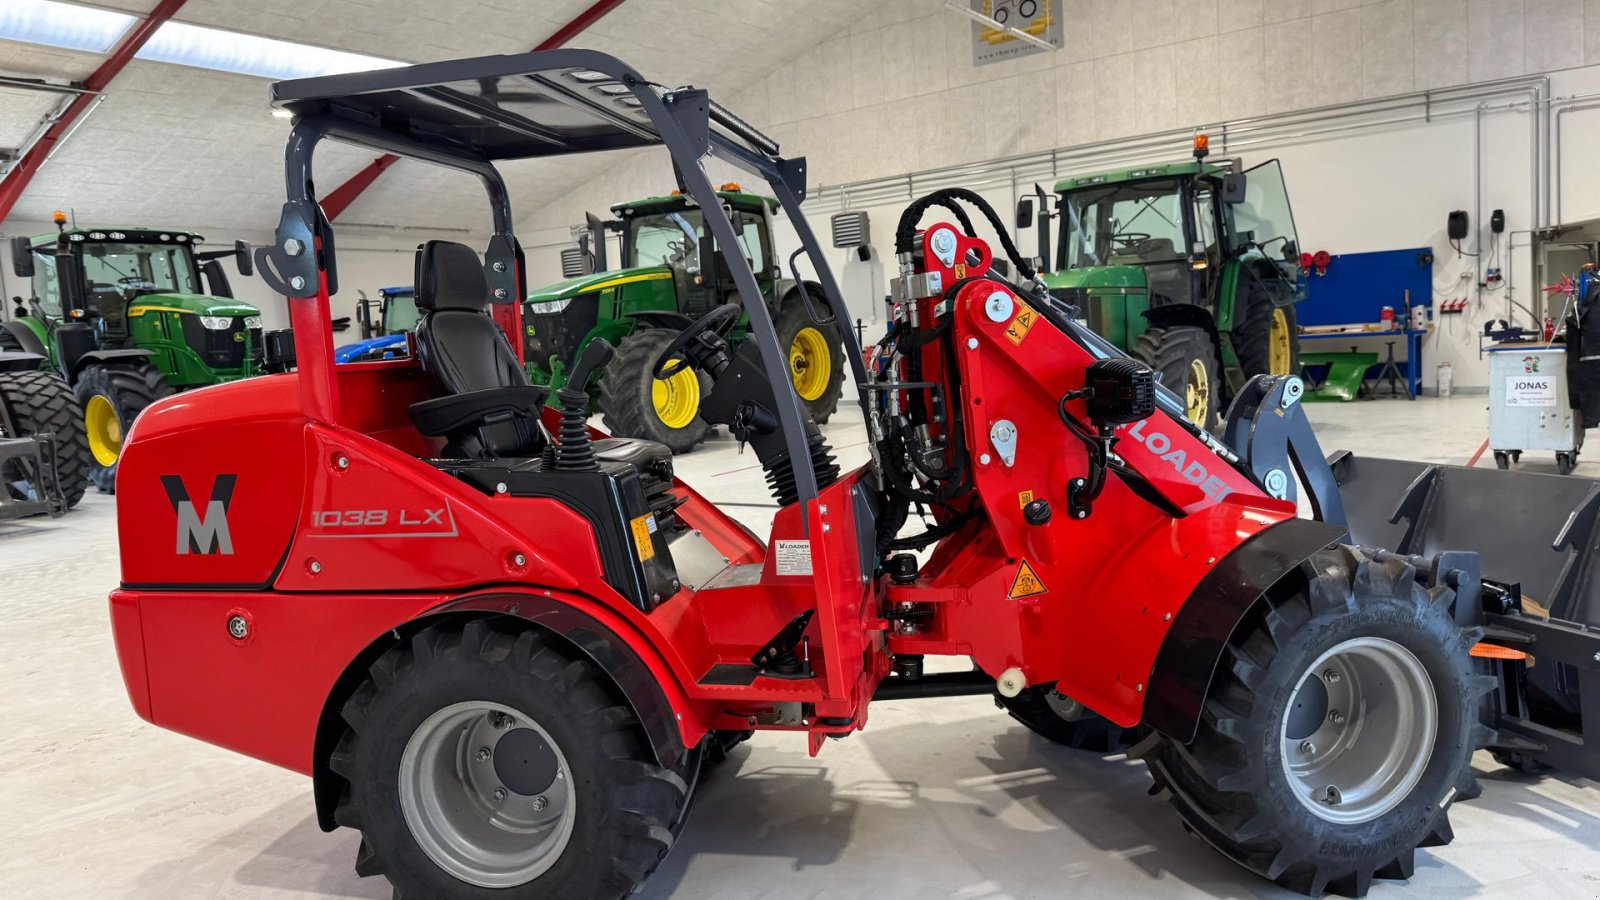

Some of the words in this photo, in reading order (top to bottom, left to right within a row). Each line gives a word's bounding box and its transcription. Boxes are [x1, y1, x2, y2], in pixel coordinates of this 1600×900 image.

[1514, 382, 1548, 390] JONAS
[313, 510, 389, 528] 1038
[400, 508, 445, 525] LX
